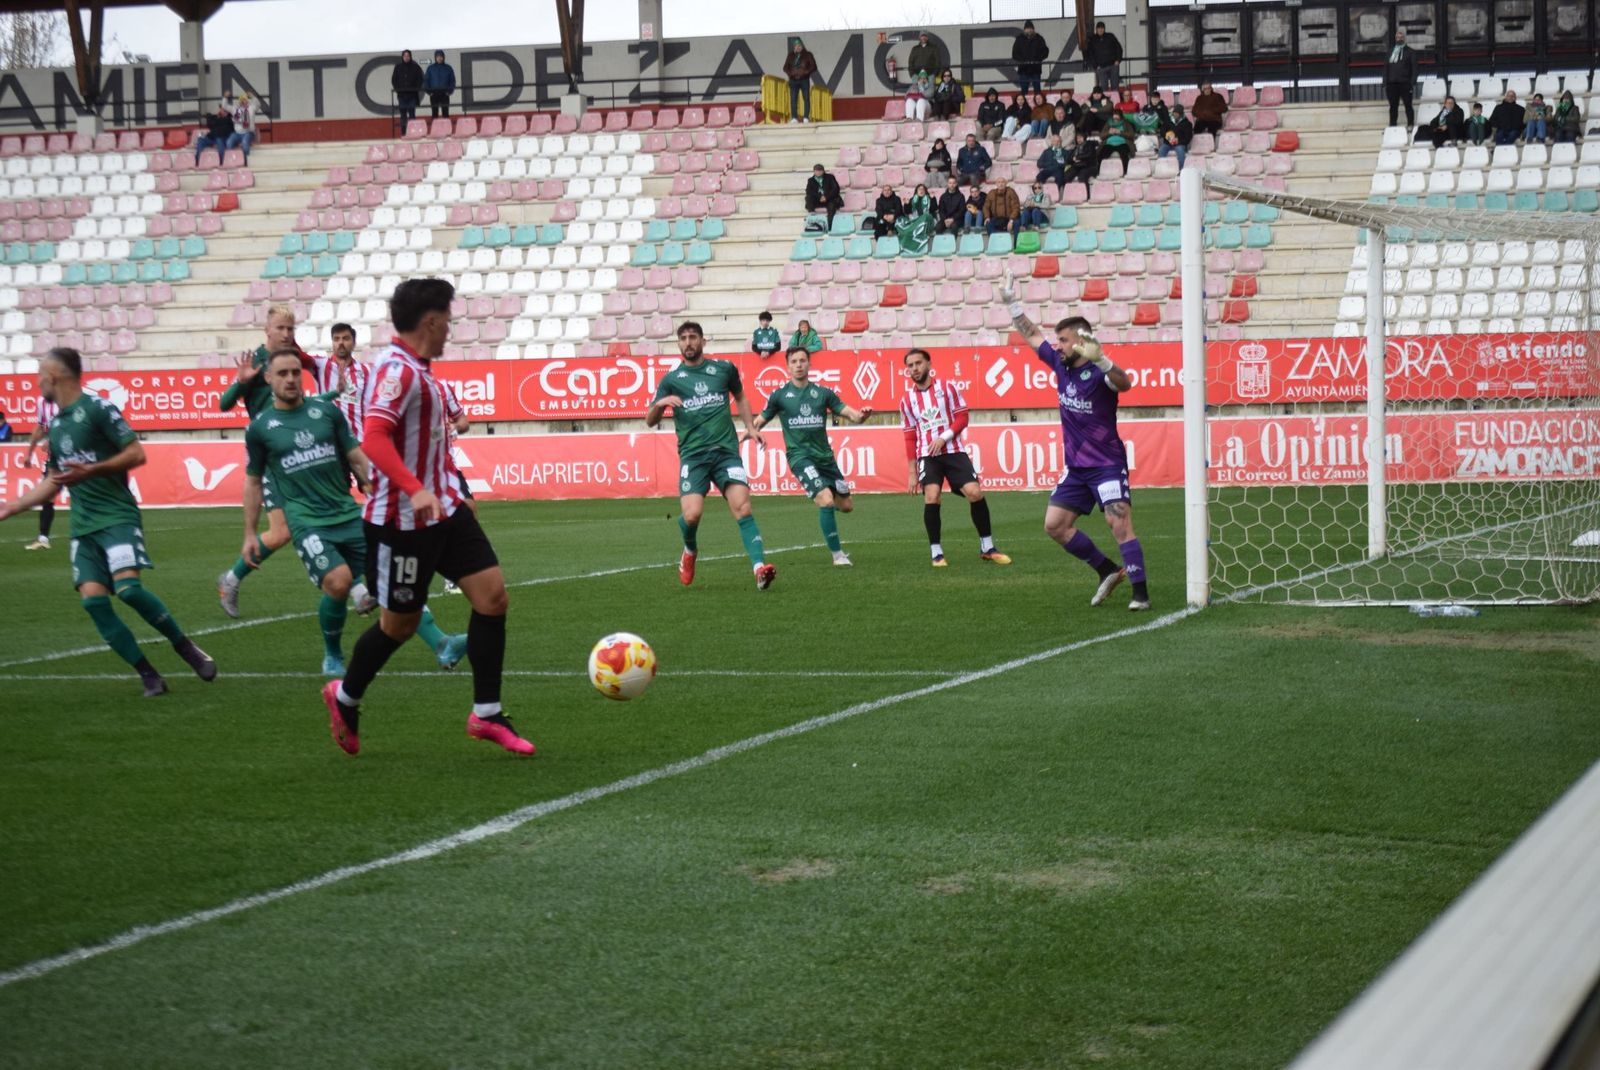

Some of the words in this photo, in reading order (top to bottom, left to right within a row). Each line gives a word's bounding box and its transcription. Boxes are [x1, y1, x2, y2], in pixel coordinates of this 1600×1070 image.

[460, 46, 594, 112] DE
[1495, 339, 1586, 362] atiendo
[130, 390, 185, 410] tres
[541, 399, 626, 410] EMBUTIDOS
[683, 392, 724, 409] columbia
[788, 414, 824, 425] columbia
[281, 442, 336, 469] columbia
[1207, 422, 1248, 468] La
[1260, 421, 1403, 482] Opinin
[492, 460, 612, 486] AISLAPRIETO,
[618, 460, 650, 483] S.L.
[681, 464, 689, 479] 4
[1217, 469, 1231, 482] El
[1236, 468, 1287, 481] Correo
[1302, 467, 1319, 479] de
[1323, 467, 1368, 480] Zamo
[781, 478, 798, 491] de
[393, 556, 418, 584] 19
